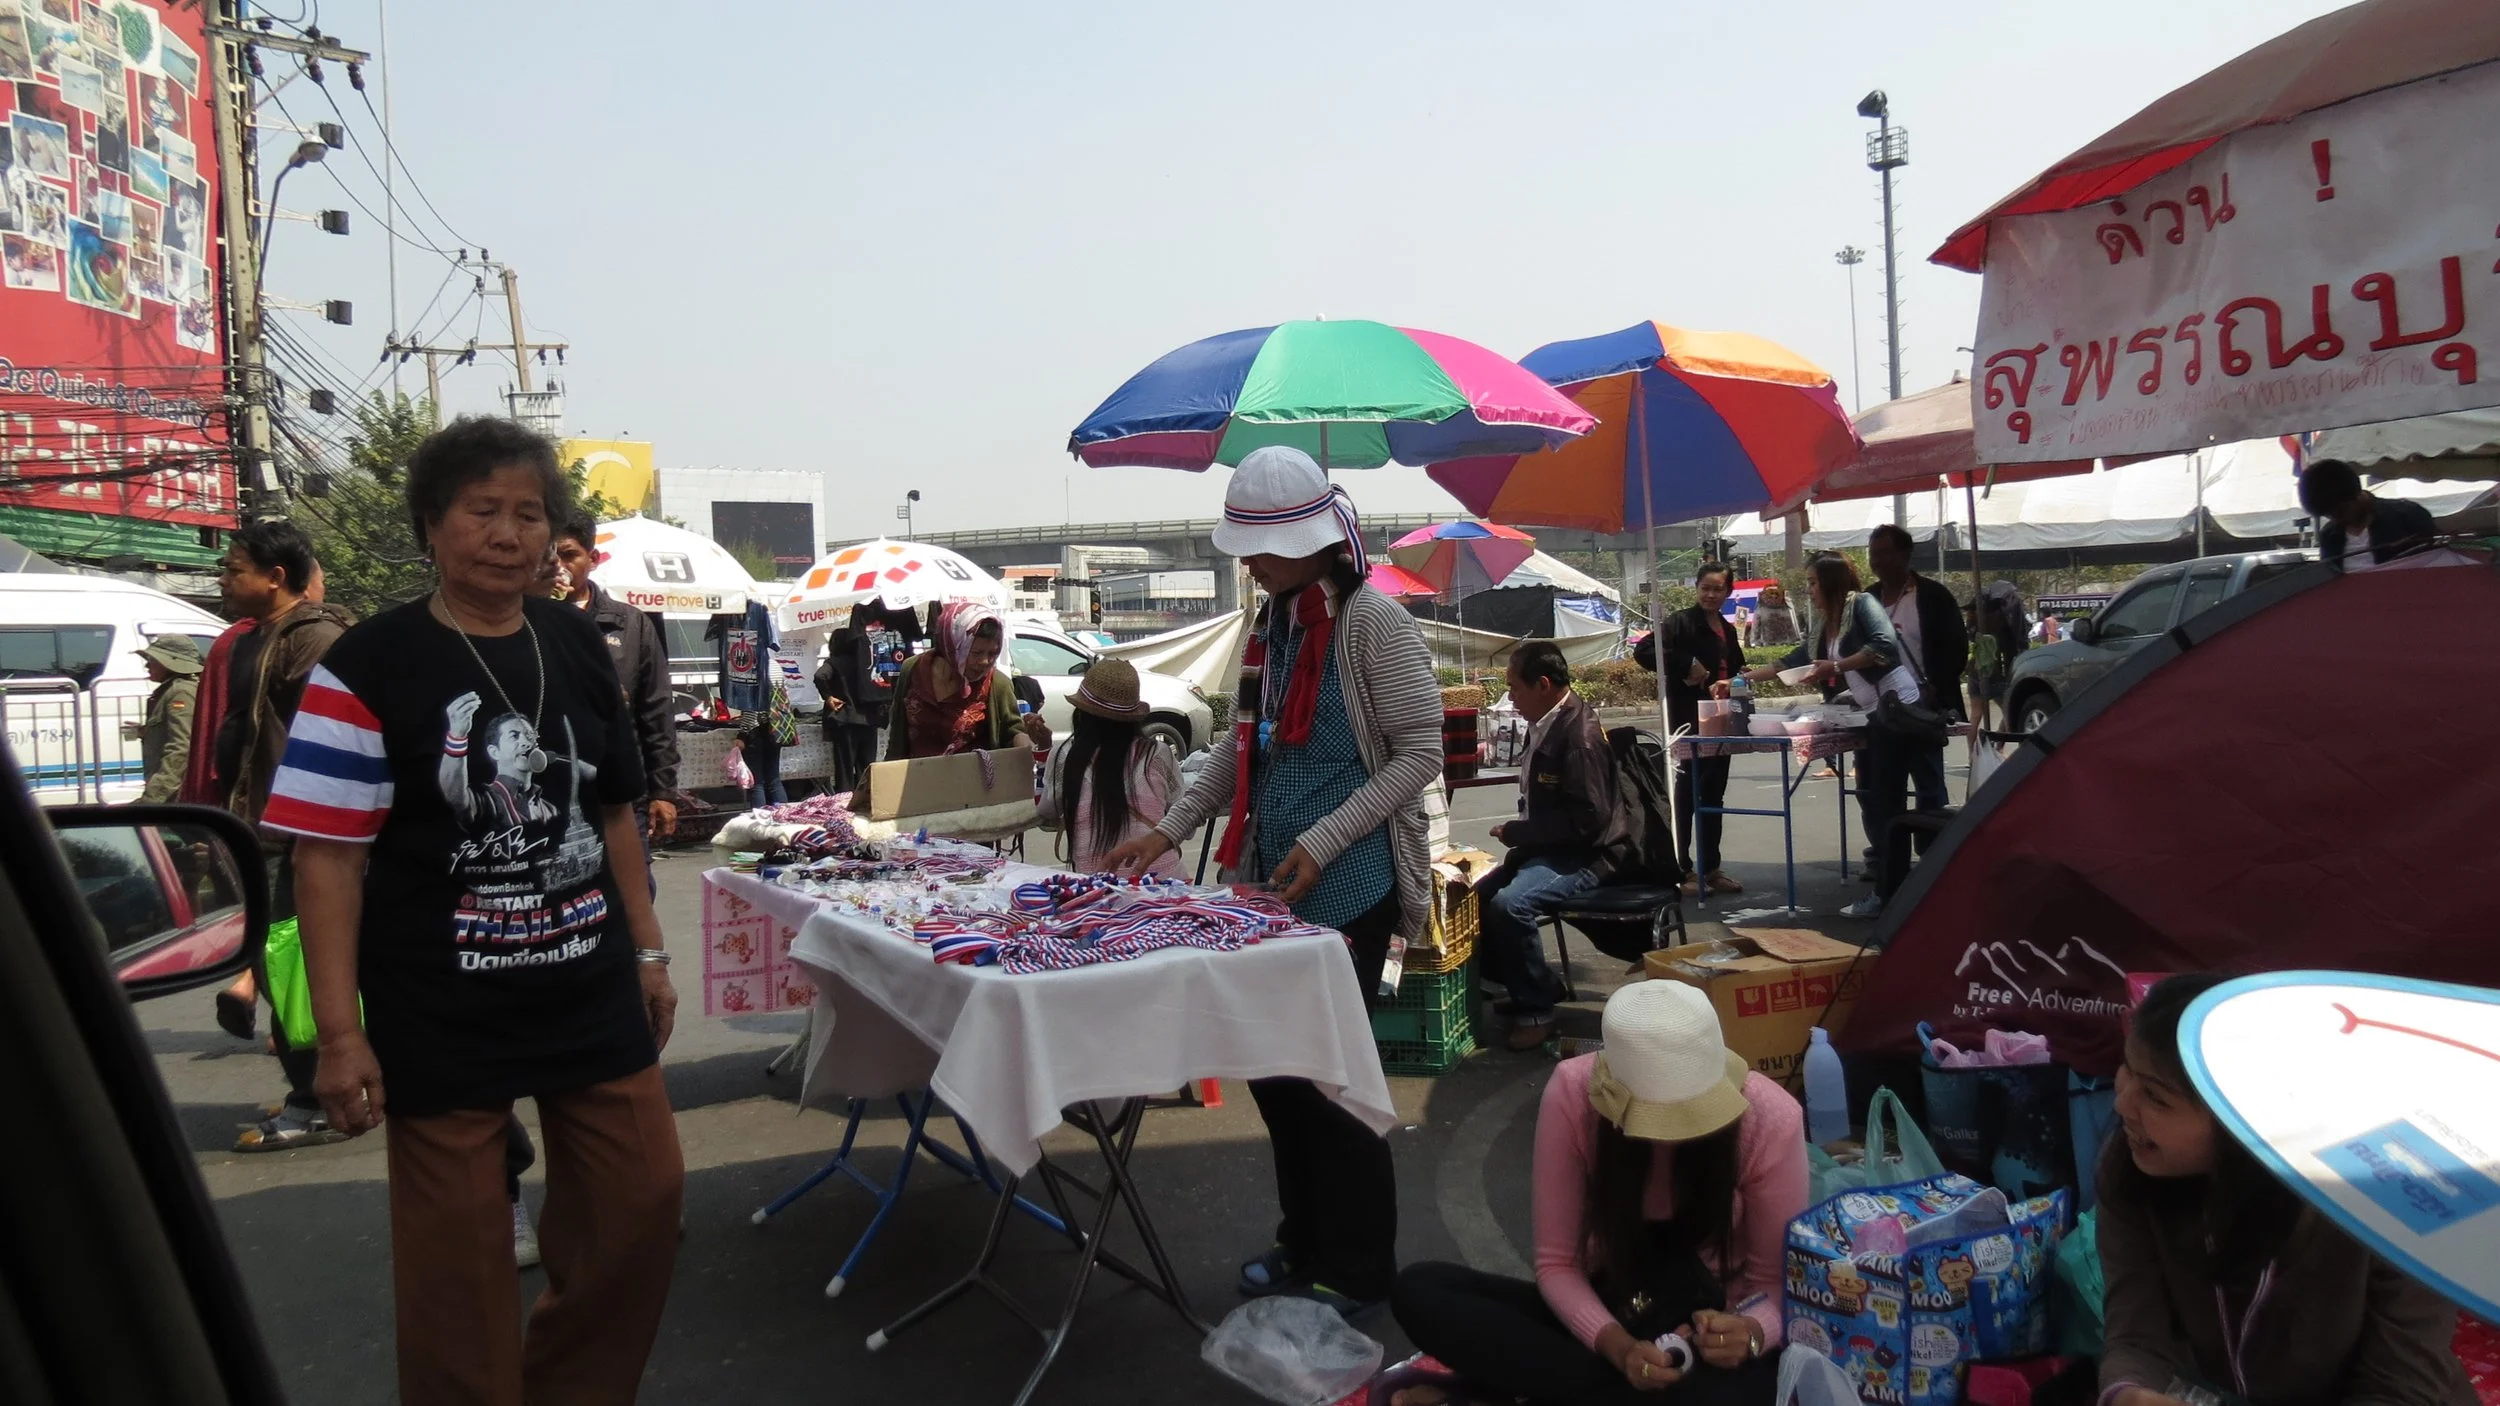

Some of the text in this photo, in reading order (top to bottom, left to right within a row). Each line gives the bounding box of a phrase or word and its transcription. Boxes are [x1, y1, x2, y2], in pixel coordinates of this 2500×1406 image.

[2094, 138, 2336, 265] ด่วน !
[1984, 224, 2500, 445] สุพรรณบุ
[453, 888, 609, 945] THAILAND
[476, 892, 545, 912] RESTART
[1967, 981, 2013, 1005] Free
